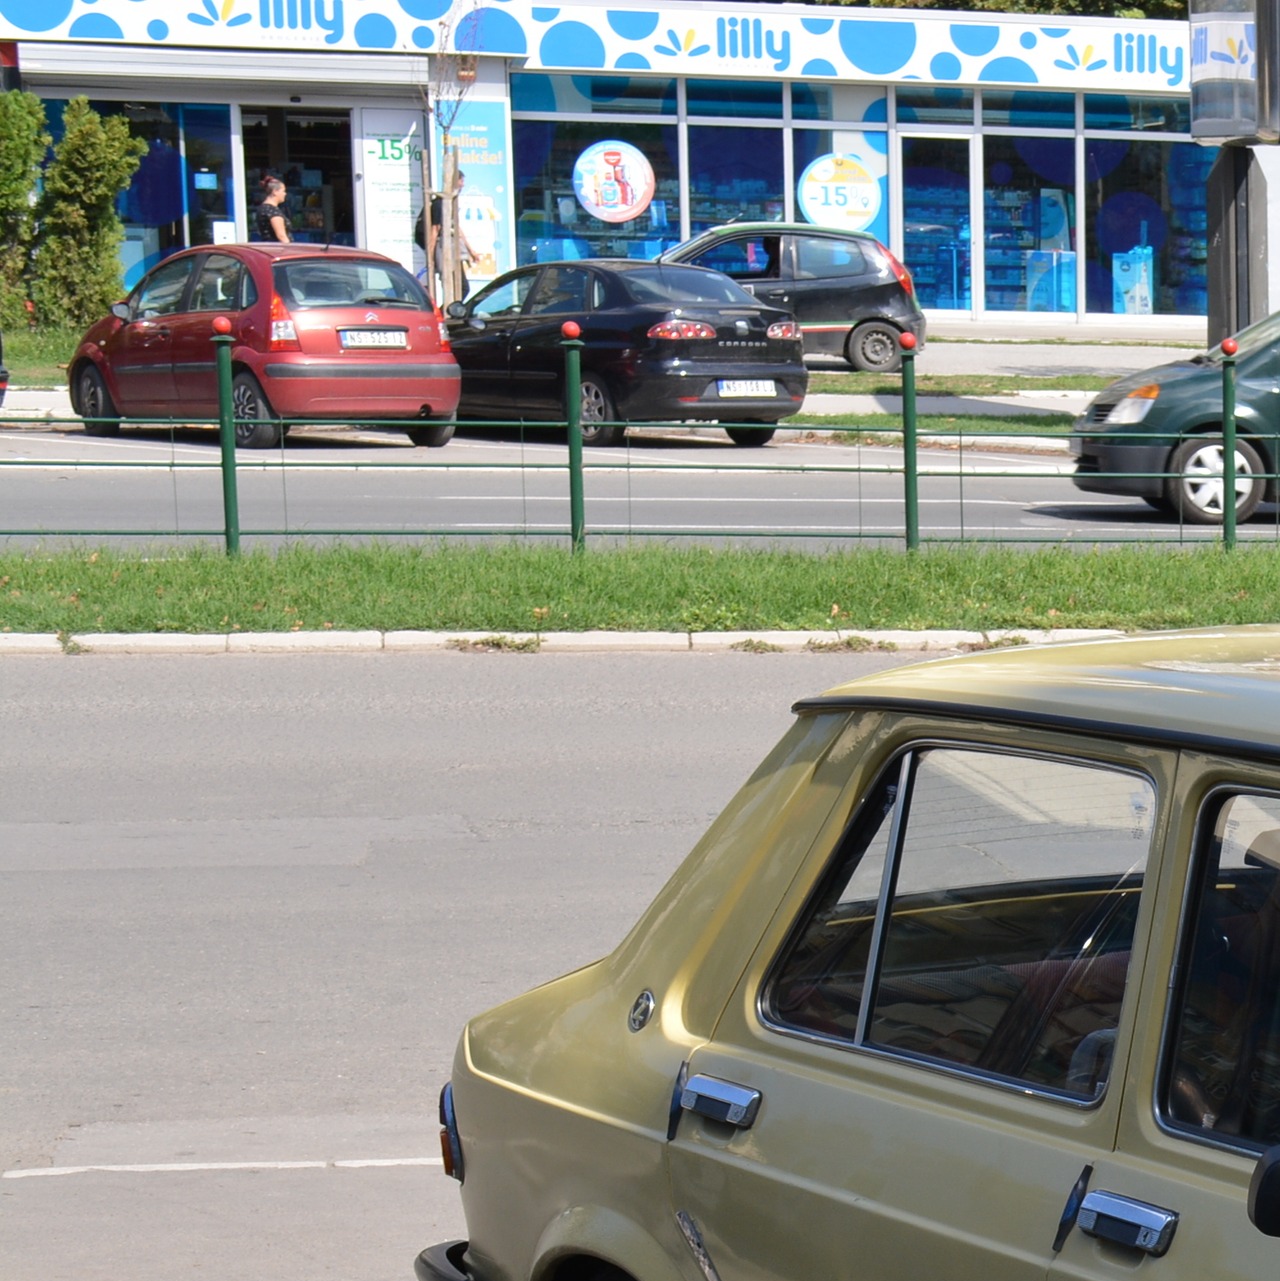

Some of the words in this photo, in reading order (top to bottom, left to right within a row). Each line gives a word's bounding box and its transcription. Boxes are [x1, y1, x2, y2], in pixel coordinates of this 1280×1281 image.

[716, 17, 791, 72] lilly
[1114, 32, 1184, 87] lilly
[367, 139, 422, 161] -15%
